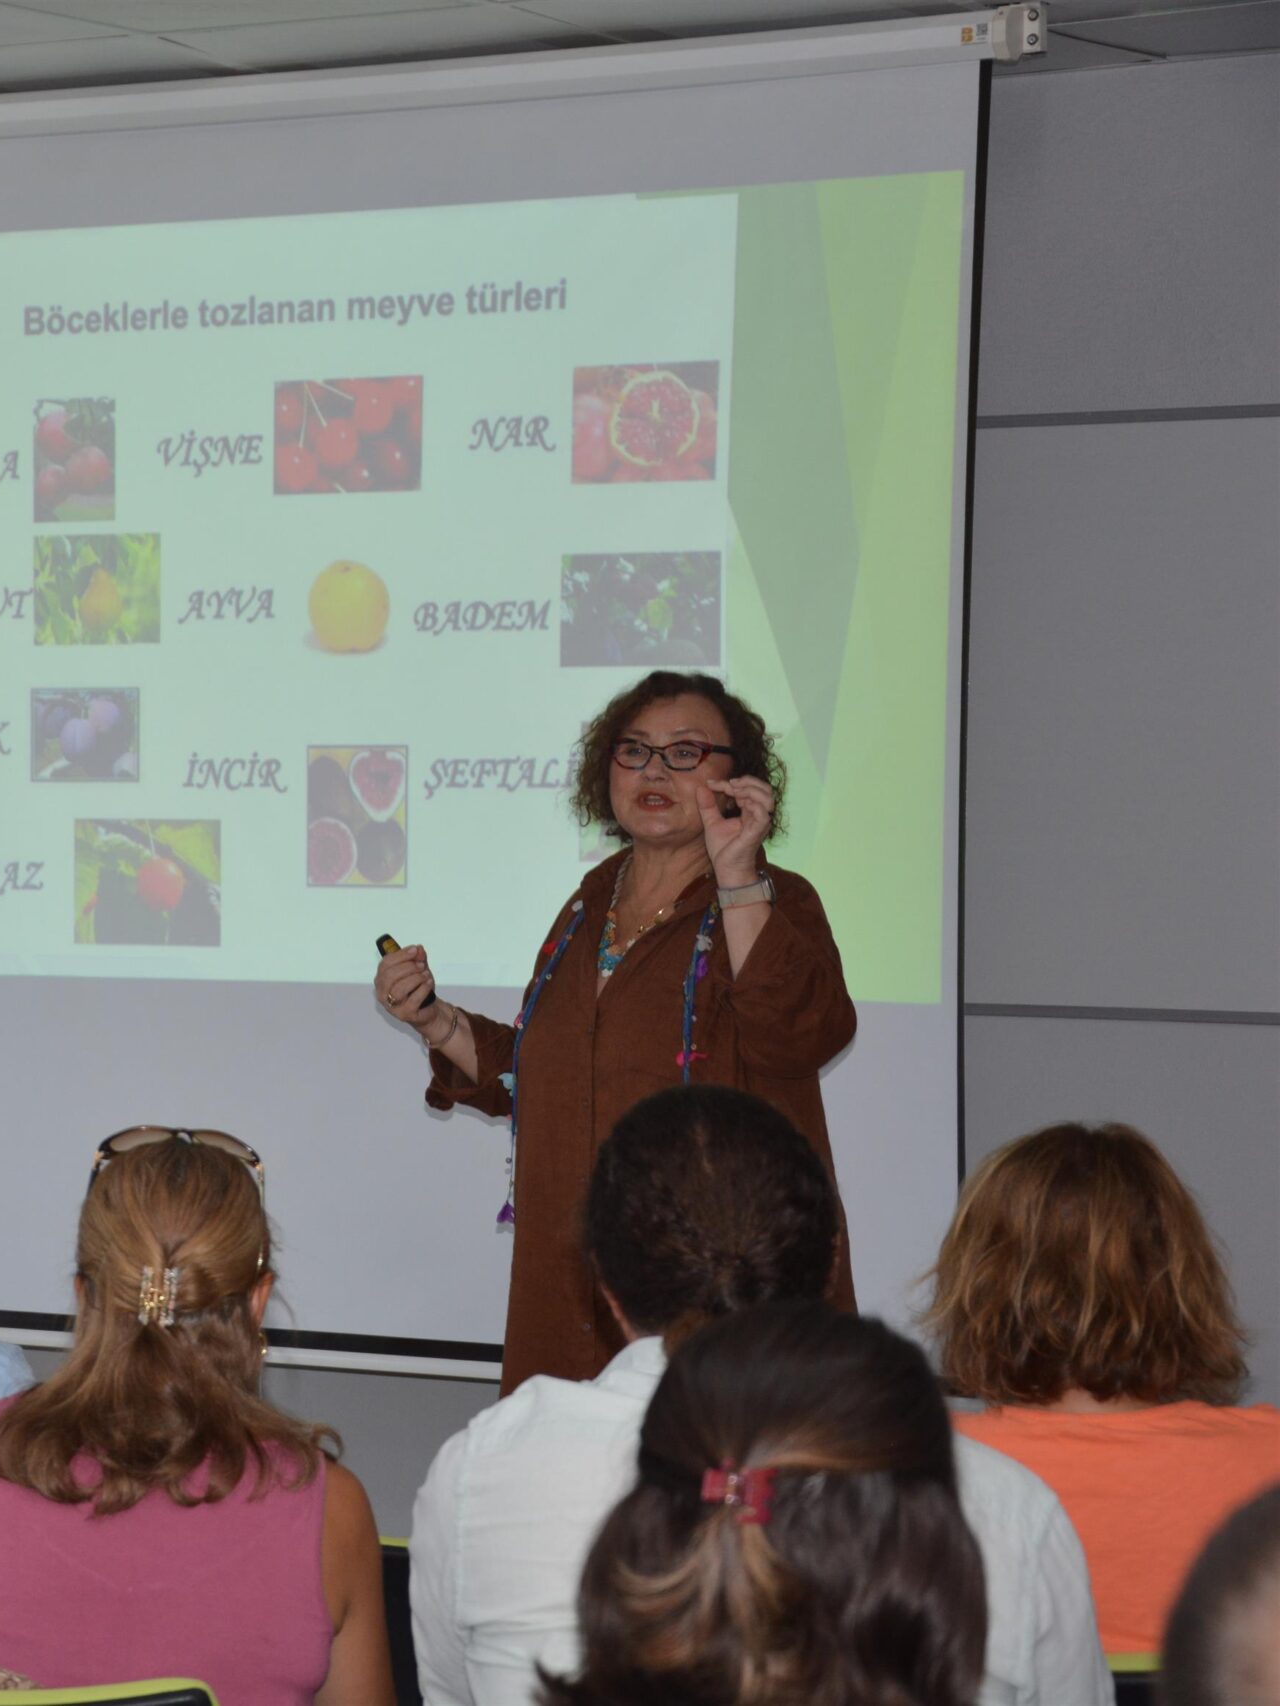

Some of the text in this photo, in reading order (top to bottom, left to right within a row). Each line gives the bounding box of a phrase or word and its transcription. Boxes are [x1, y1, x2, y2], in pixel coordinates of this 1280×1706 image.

[23, 278, 568, 336] Böceklerle tozlanan meyve türleri
[156, 430, 263, 477] VİŞNE
[469, 416, 556, 452] NAR
[177, 585, 276, 625] AYVA
[413, 599, 551, 636] BADEM
[181, 752, 289, 794] İNCİR
